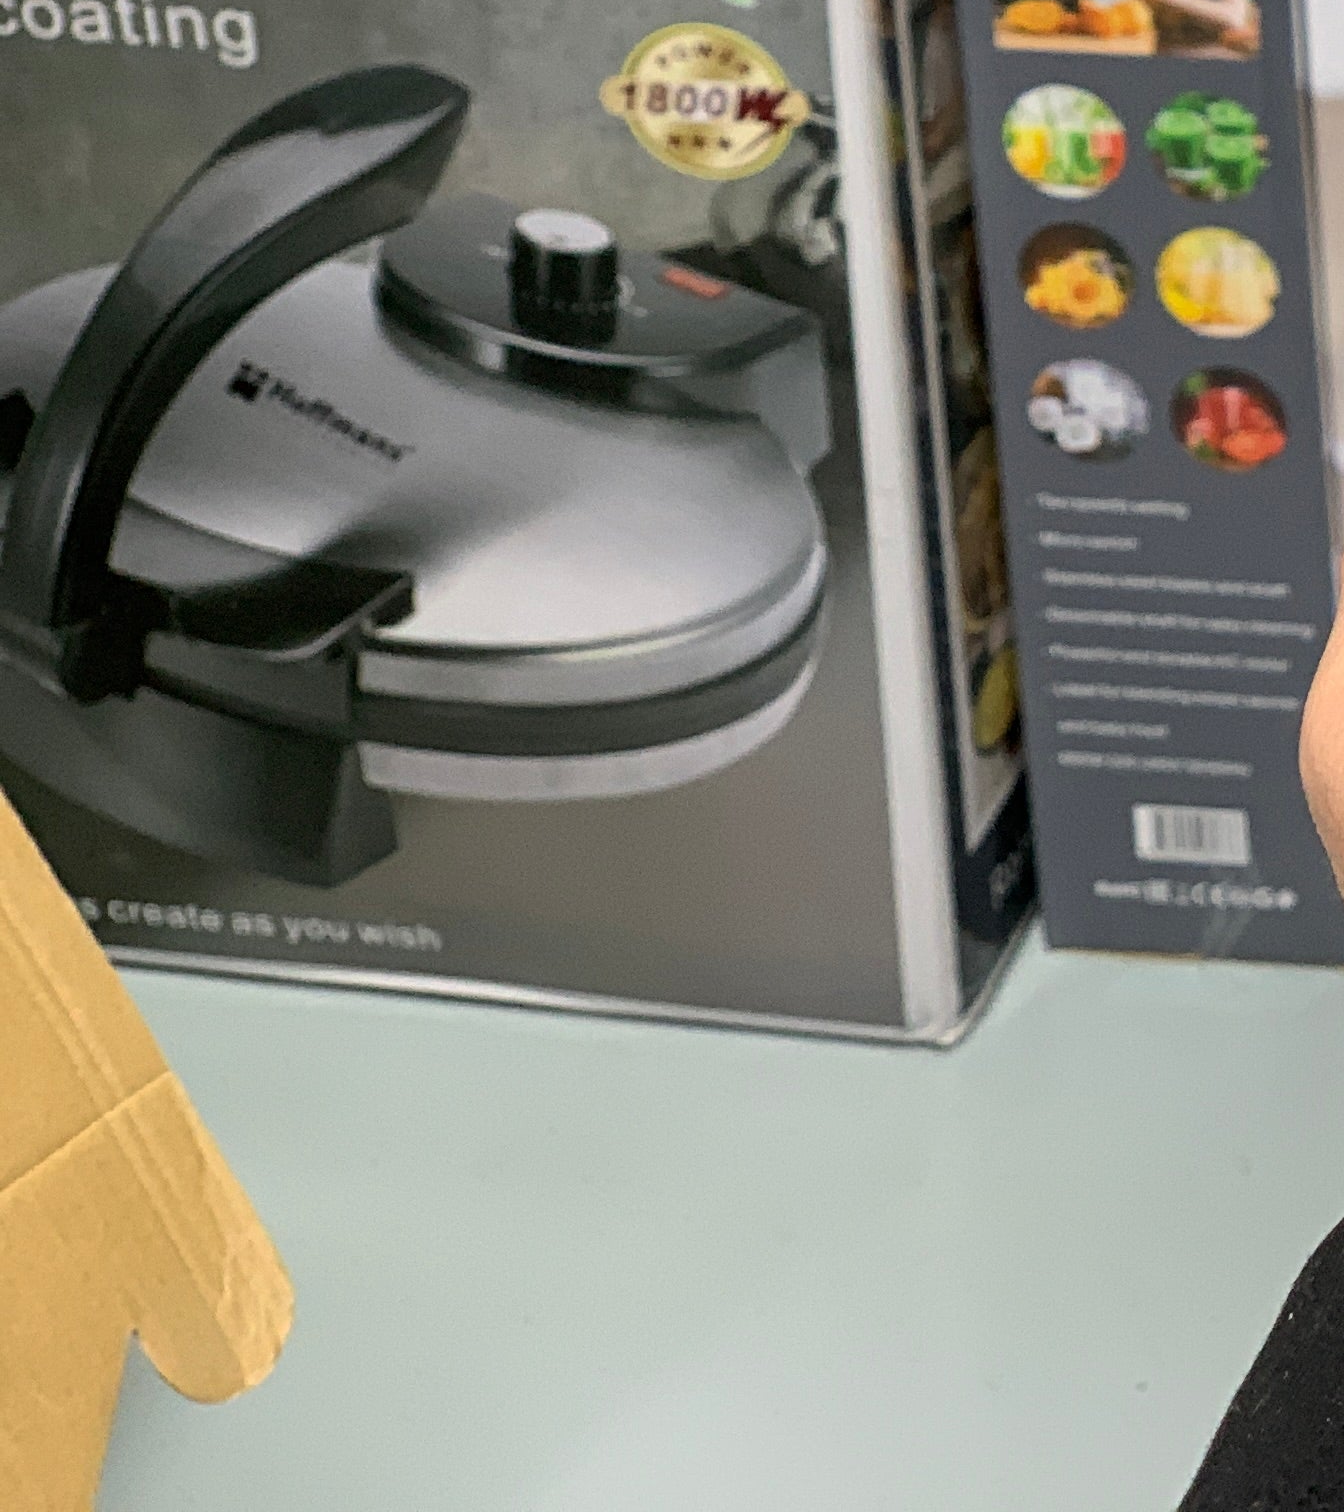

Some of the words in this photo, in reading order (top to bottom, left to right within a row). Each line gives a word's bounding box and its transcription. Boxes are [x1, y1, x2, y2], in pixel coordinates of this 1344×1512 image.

[106, 899, 224, 933] create
[231, 912, 275, 937] as
[281, 916, 350, 944] you
[357, 923, 444, 953] wish
